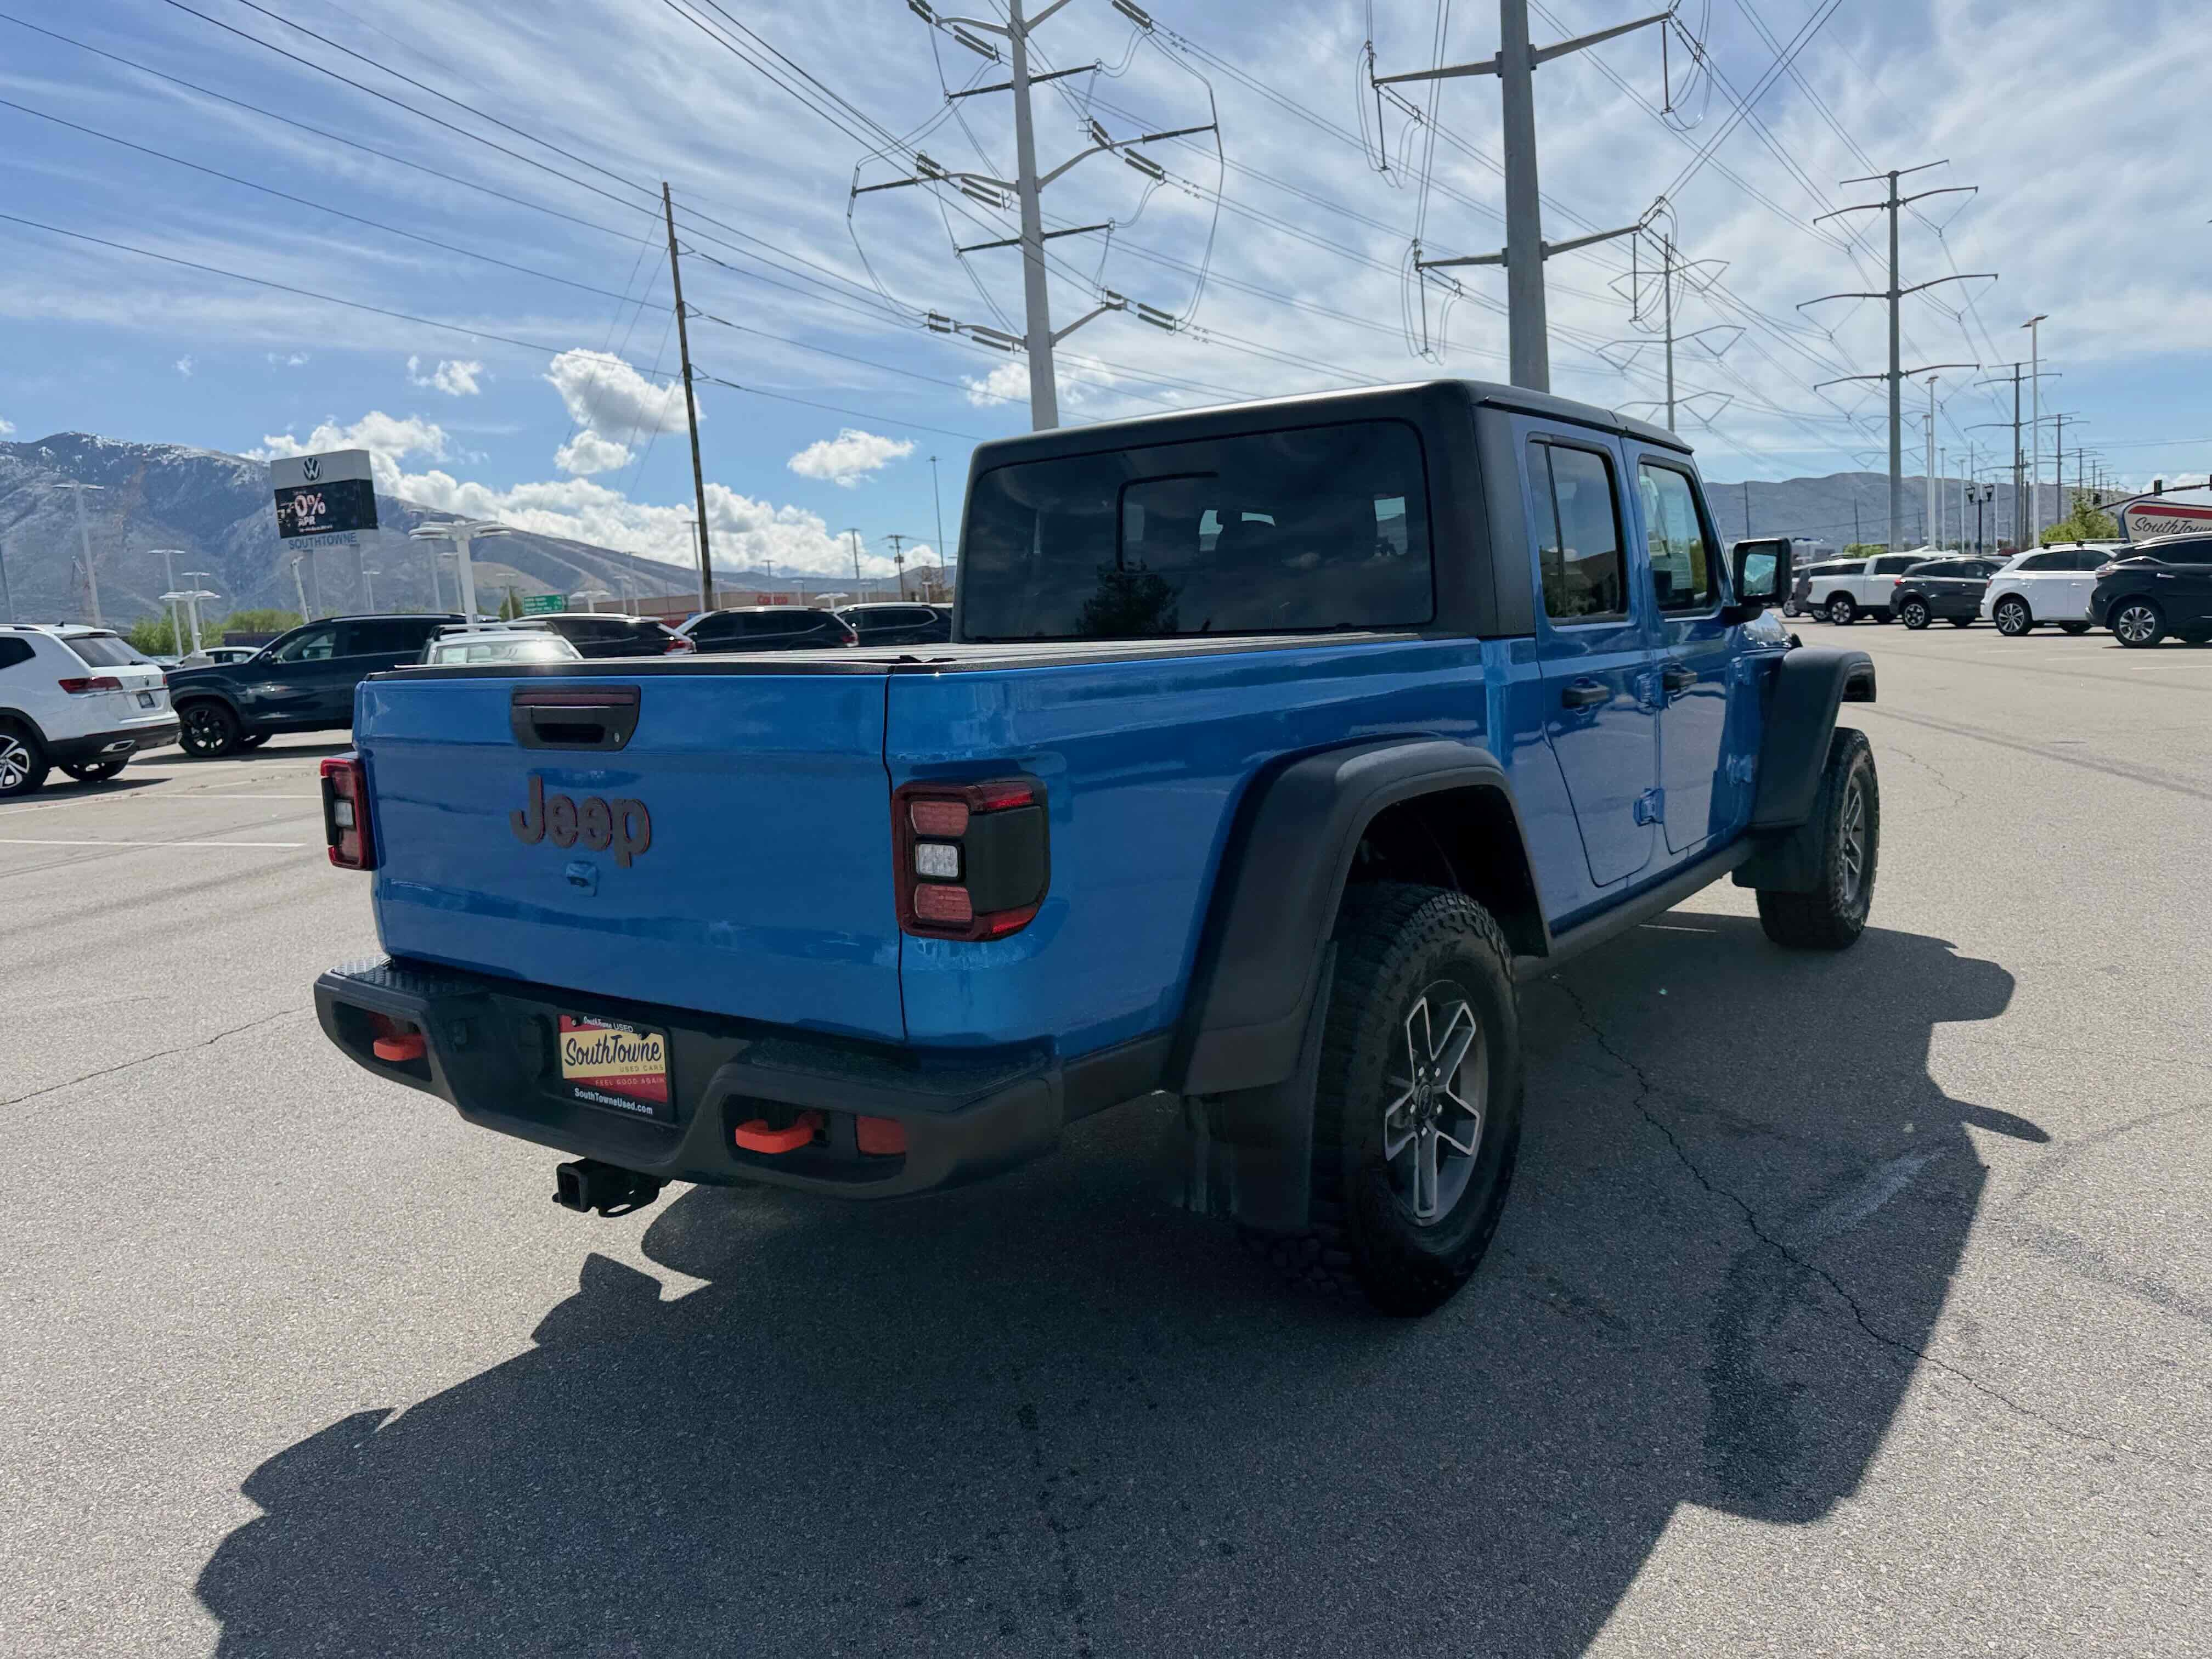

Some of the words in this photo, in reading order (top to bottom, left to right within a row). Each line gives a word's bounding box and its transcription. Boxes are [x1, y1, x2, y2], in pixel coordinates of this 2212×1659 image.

[289, 532, 357, 549] SOUTHTOWNE
[509, 774, 652, 868] Jeep
[583, 1016, 612, 1029] SouthTowne
[614, 1023, 634, 1032] USED
[565, 1034, 662, 1066] SouthTowne
[575, 1088, 653, 1115] SouthTowneUsed.com
